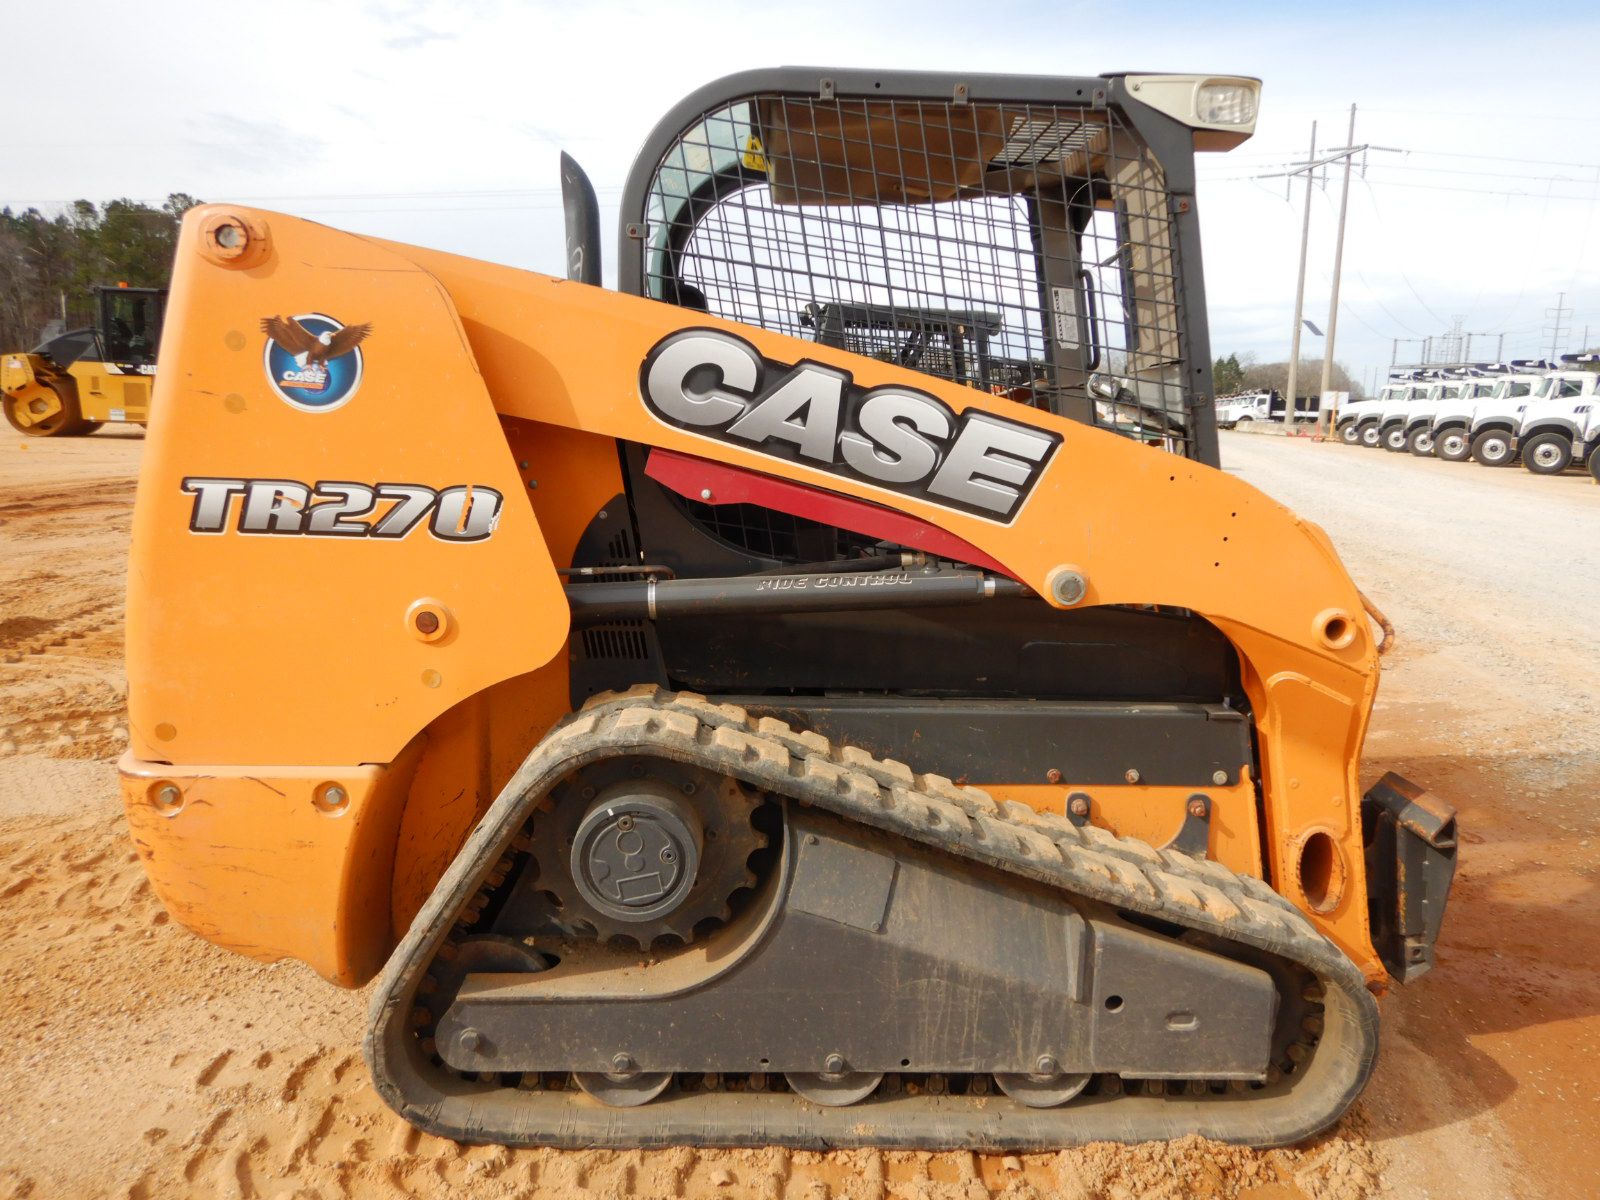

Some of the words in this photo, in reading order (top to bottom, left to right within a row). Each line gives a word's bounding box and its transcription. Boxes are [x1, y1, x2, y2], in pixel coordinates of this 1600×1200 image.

[283, 370, 327, 383] CASE
[640, 326, 1064, 528] CASE
[181, 477, 503, 542] TR270
[756, 577, 809, 591] RIDE
[814, 573, 913, 588] CONTROL
